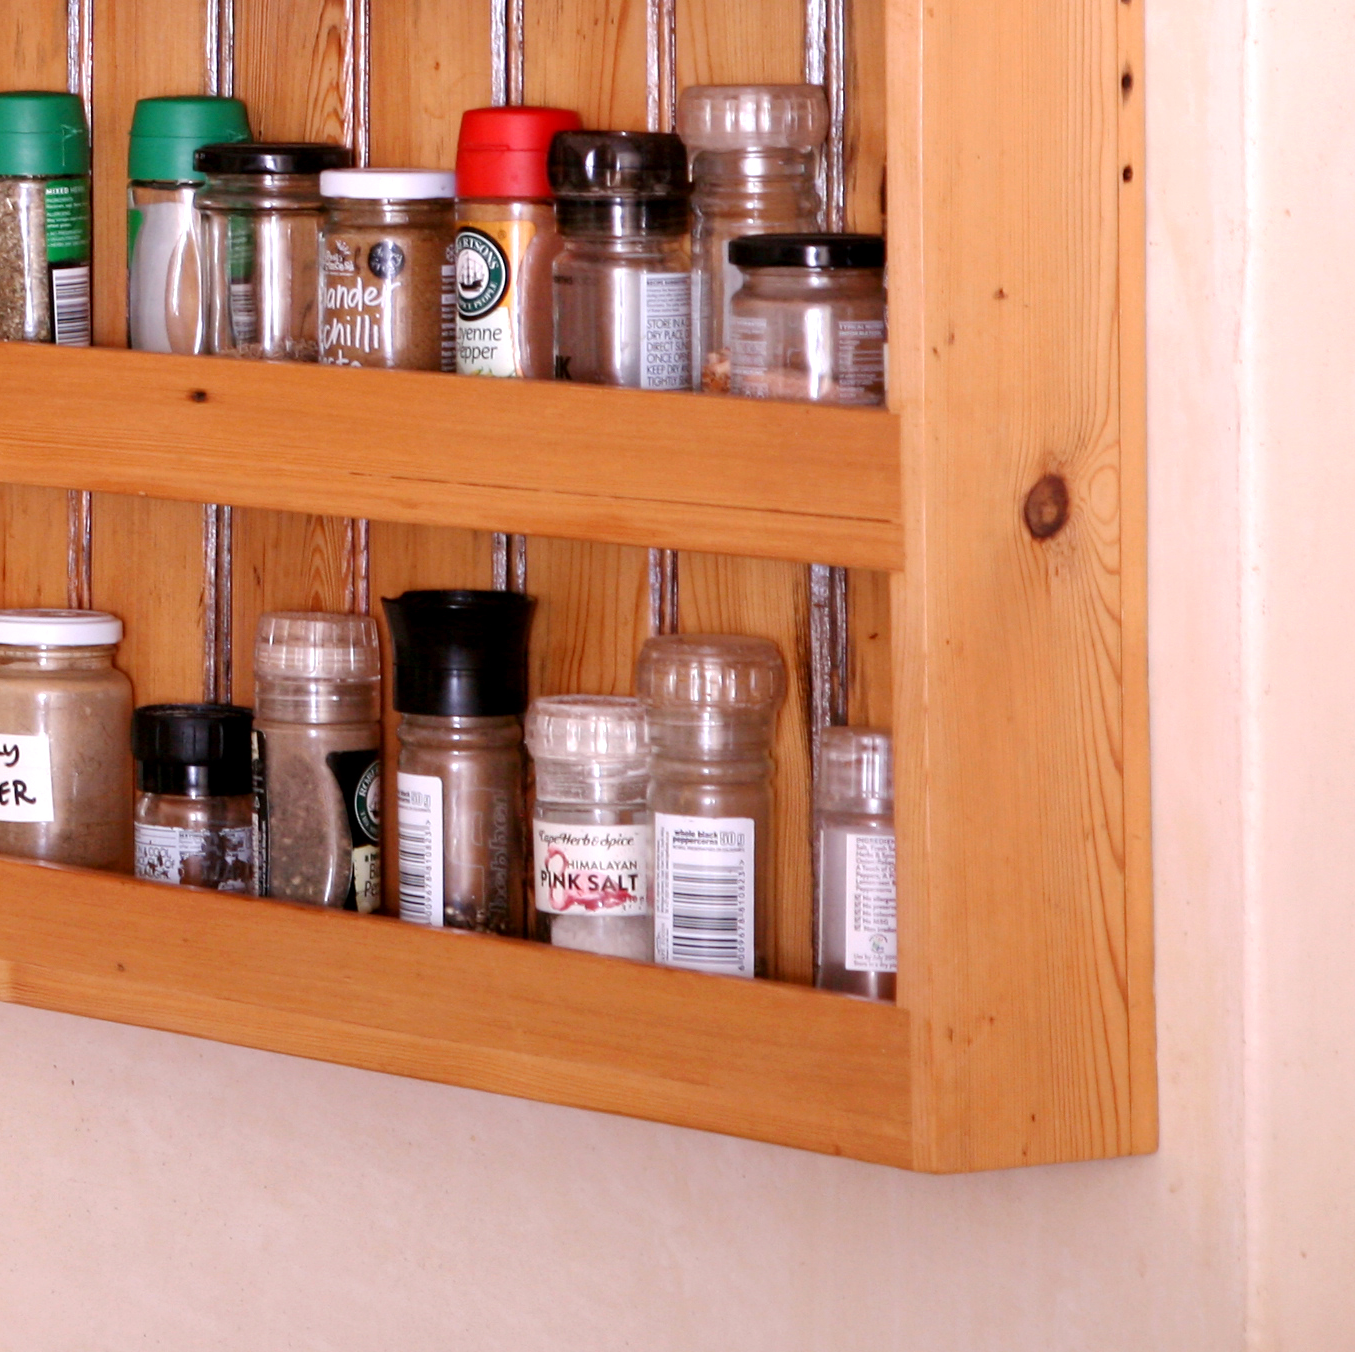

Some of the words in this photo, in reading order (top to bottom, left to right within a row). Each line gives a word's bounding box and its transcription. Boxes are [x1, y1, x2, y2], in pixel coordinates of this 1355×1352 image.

[45, 186, 70, 195] MIXED
[646, 319, 672, 329] STORE
[672, 319, 680, 329] IN
[646, 330, 663, 341] DRY
[664, 330, 685, 340] PLACE
[646, 342, 674, 352] DIRECT
[646, 353, 672, 363] ONCE
[646, 364, 666, 374] KEEP
[666, 364, 681, 374] DRY
[647, 376, 678, 387] TIGHTLY
[674, 829, 696, 838] whole
[697, 829, 718, 839] black
[560, 833, 591, 846] Herb
[600, 832, 634, 850] Spice
[672, 836, 719, 846] peppercorns
[567, 860, 638, 871] HIMALAYAN
[540, 869, 582, 891] PINK
[587, 874, 639, 892] SALT
